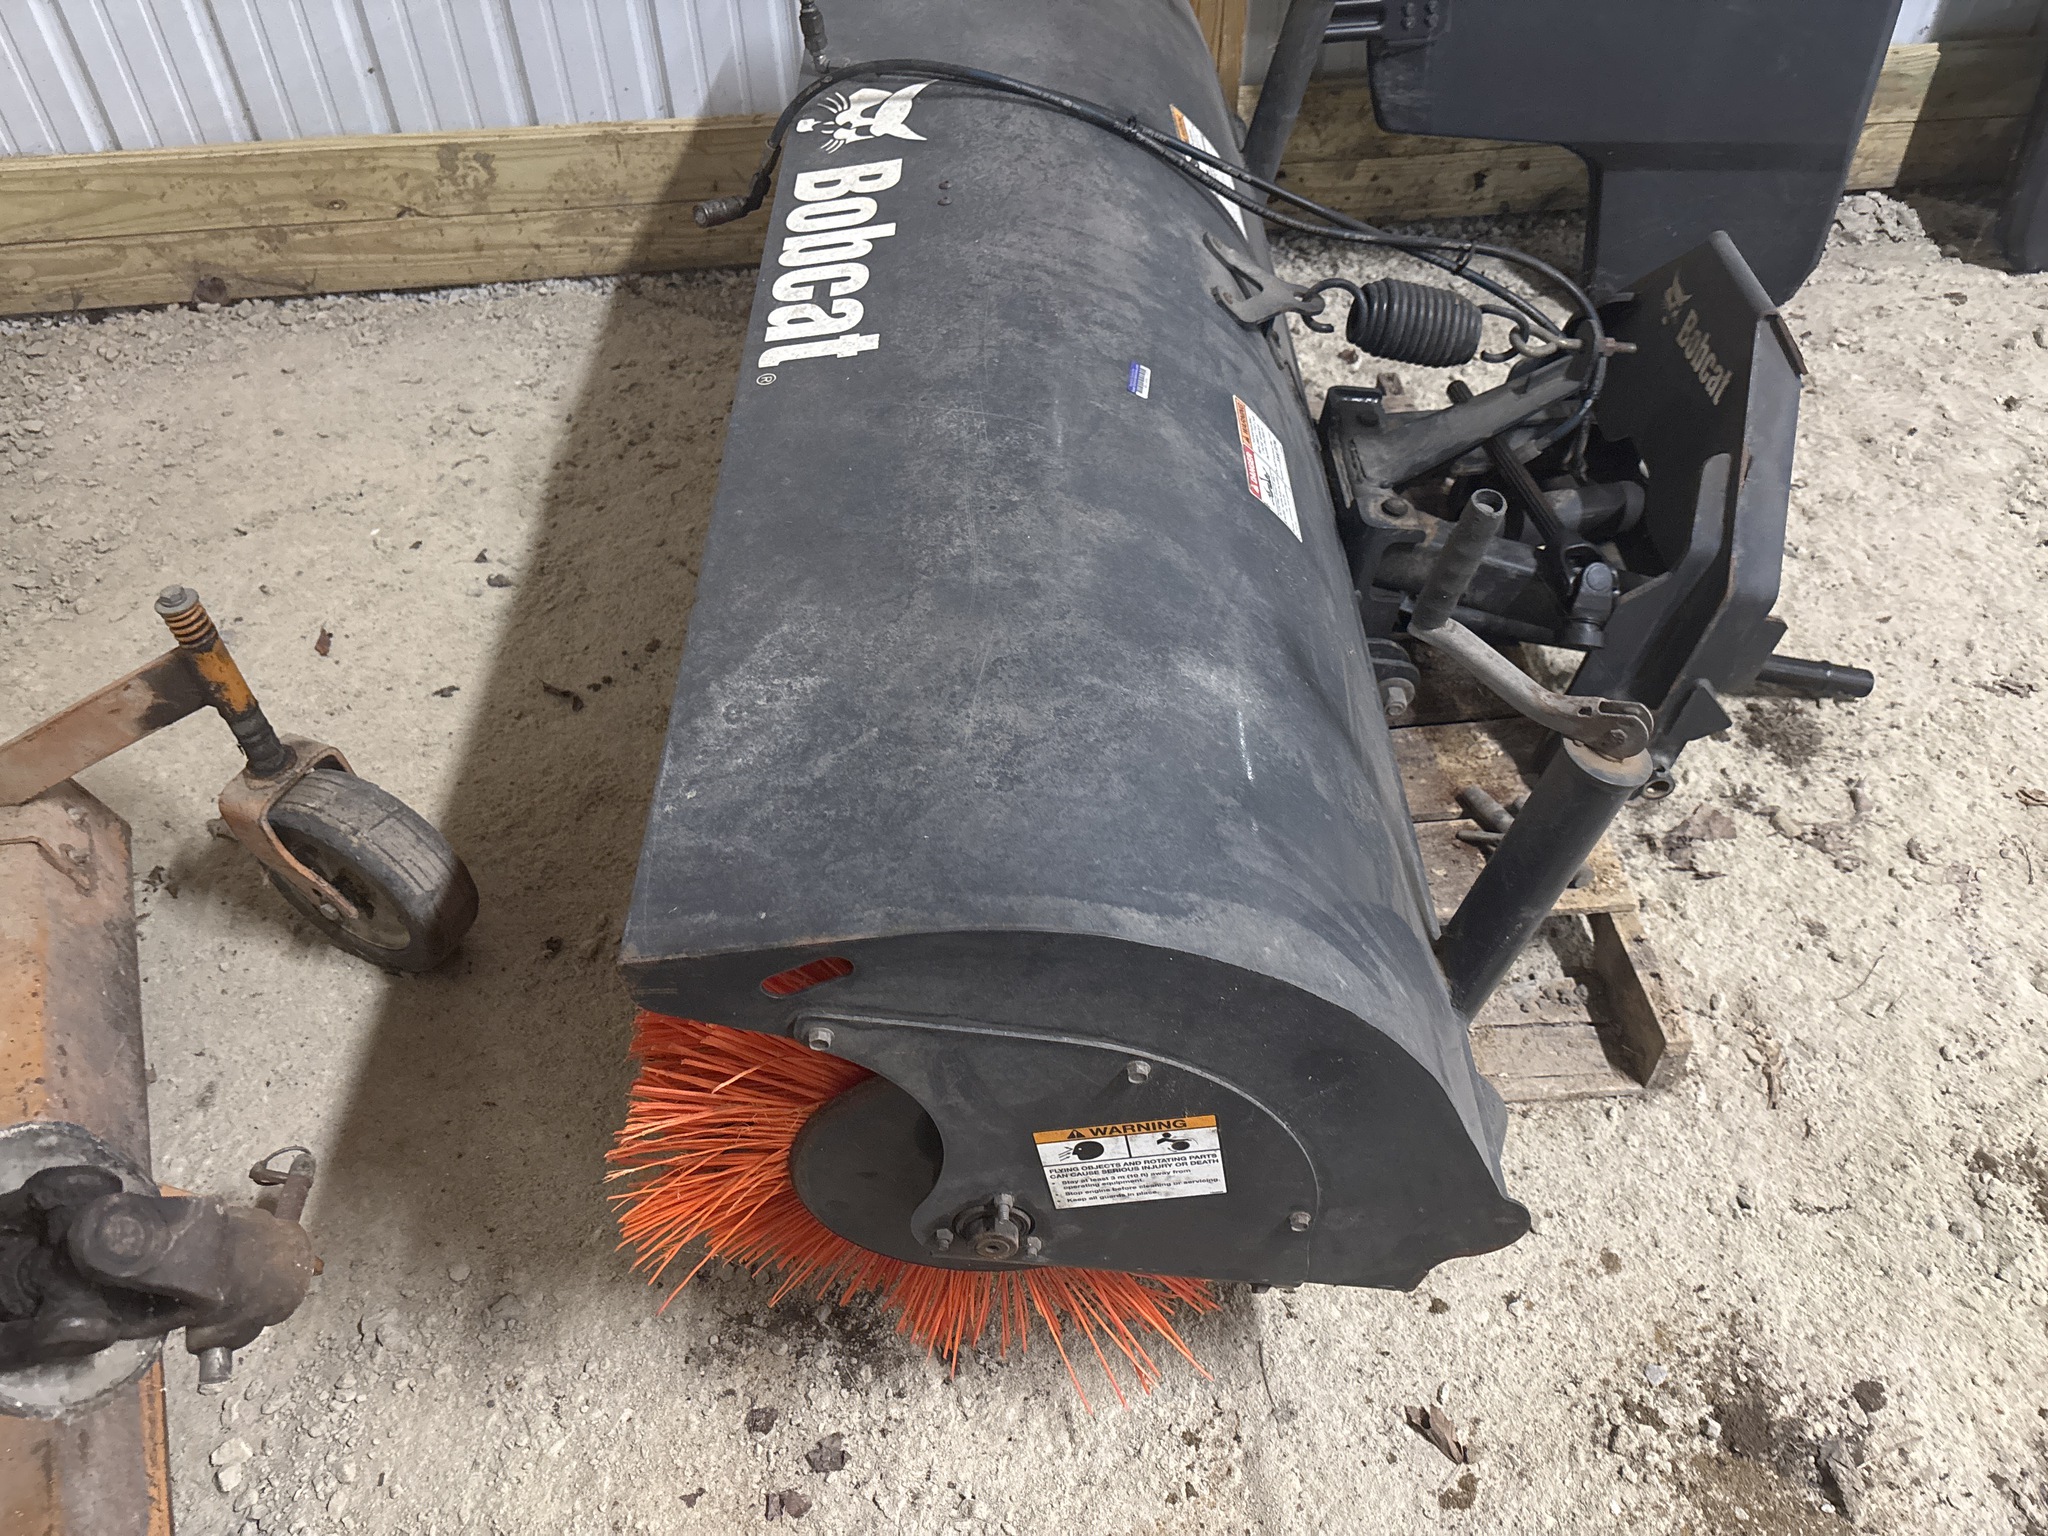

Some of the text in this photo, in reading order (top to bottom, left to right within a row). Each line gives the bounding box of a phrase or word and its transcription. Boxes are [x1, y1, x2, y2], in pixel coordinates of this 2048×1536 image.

[758, 158, 903, 368] Bobcat
[1676, 309, 1734, 406] Bobcat
[1089, 1119, 1187, 1137] WARNING
[1049, 1166, 1079, 1174] FLYING
[1081, 1163, 1121, 1171] OBJECTS
[1144, 1156, 1187, 1165] ROTATING
[1101, 1167, 1140, 1175] SERIOUS
[1142, 1163, 1173, 1171] INJURY
[1063, 1182, 1100, 1190] operating
[1139, 1181, 1172, 1189] cleaning
[1099, 1193, 1126, 1201] guards
